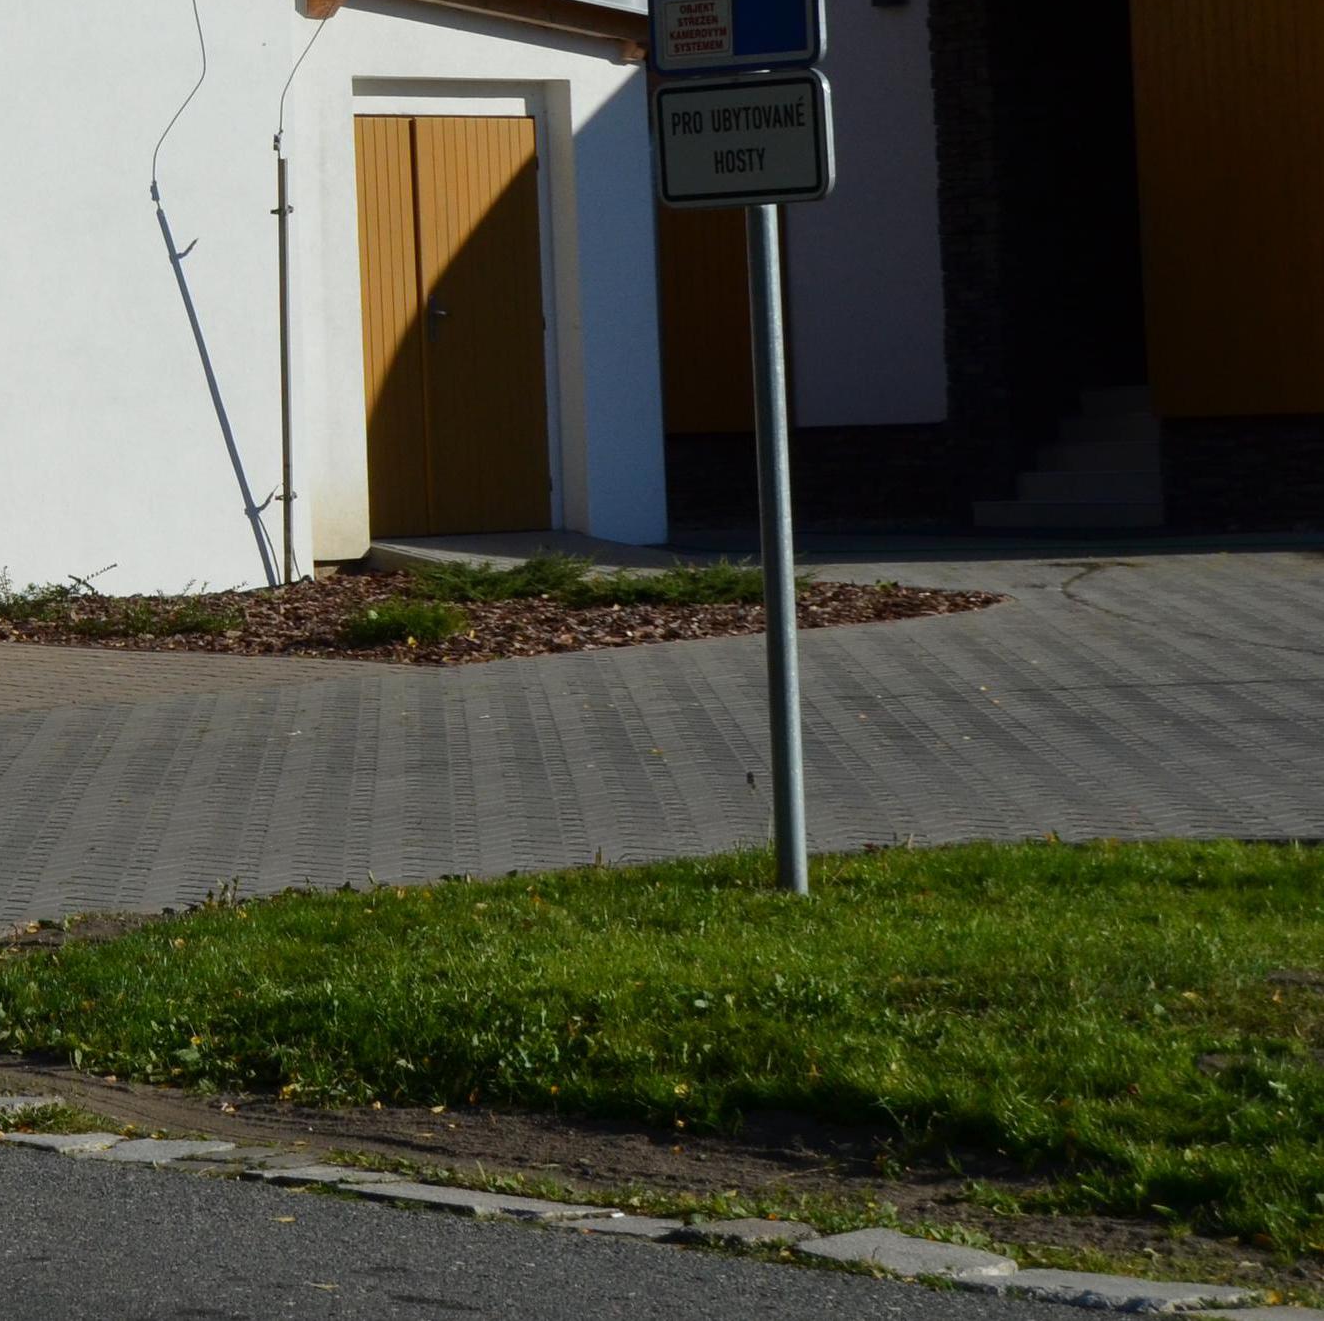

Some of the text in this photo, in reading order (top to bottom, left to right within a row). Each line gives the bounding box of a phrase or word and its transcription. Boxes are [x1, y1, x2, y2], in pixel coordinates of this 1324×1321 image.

[679, 2, 715, 14] OBJEKT
[671, 96, 806, 136] PRO UBYTOVANÉ
[714, 147, 766, 174] HOSTY
